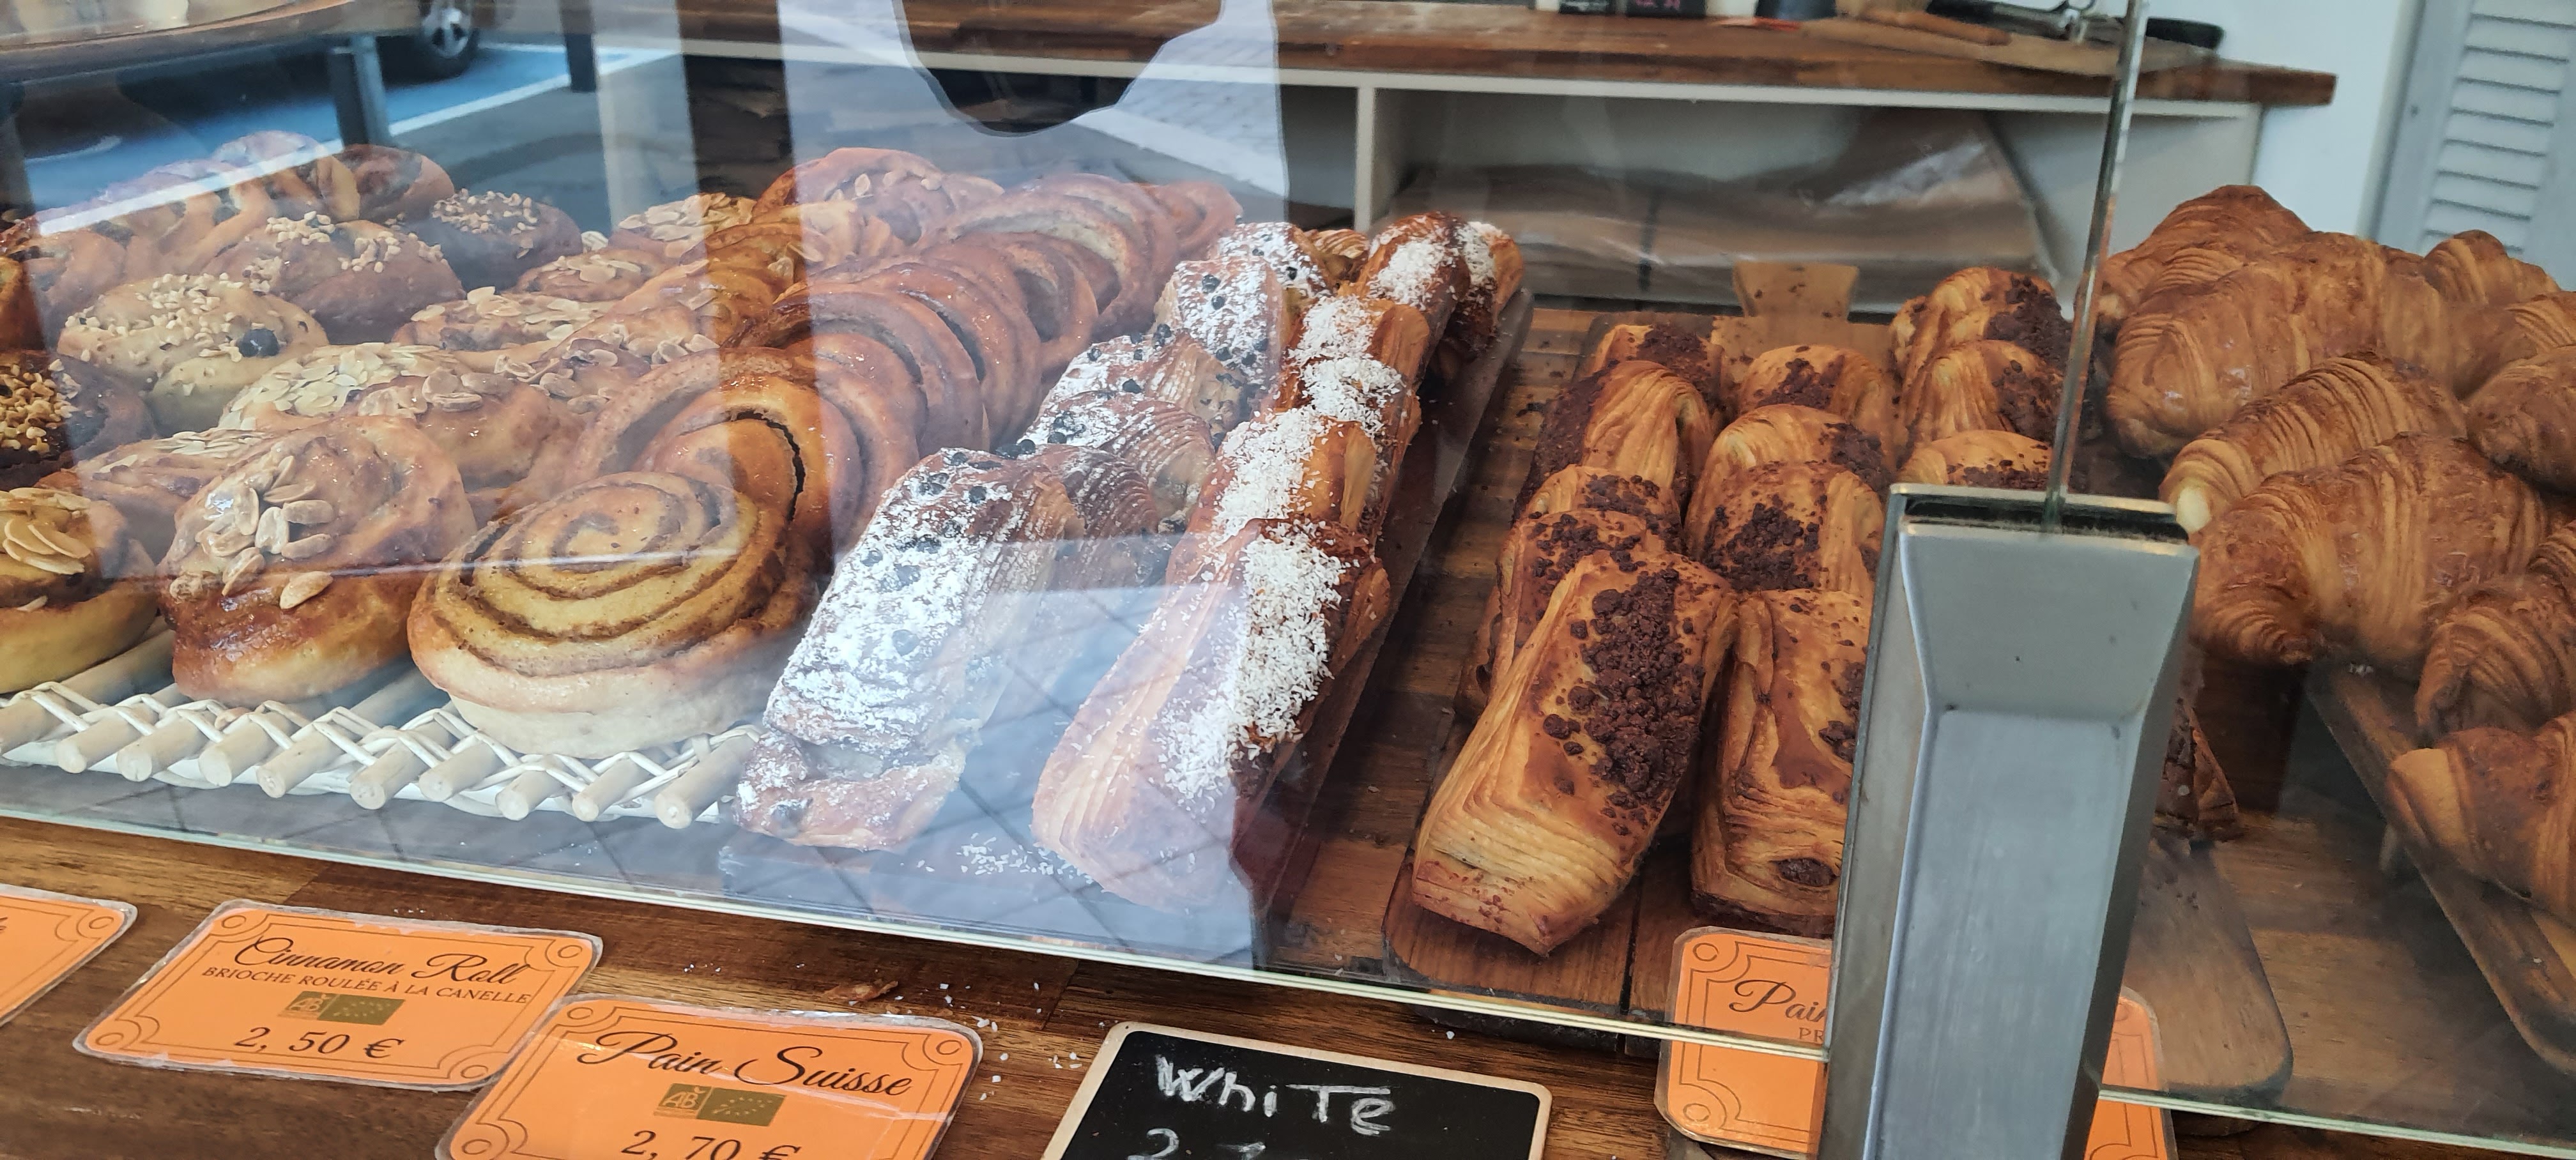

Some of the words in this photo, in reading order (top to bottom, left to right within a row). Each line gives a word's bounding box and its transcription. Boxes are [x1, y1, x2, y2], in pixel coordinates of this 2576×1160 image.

[234, 936, 405, 975] Cinnamon
[411, 953, 530, 984] Roll
[202, 966, 296, 984] BRIOCHE
[298, 975, 383, 991] ROULÉE
[384, 981, 400, 993] À
[404, 984, 429, 996] LA
[436, 987, 532, 1004] CANELLE
[234, 1026, 269, 1053] 2,
[288, 1031, 351, 1055] 50
[363, 1038, 405, 1059] €
[576, 1031, 723, 1074] Pain
[734, 1046, 913, 1096] Suisse
[685, 1136, 742, 1160] 70
